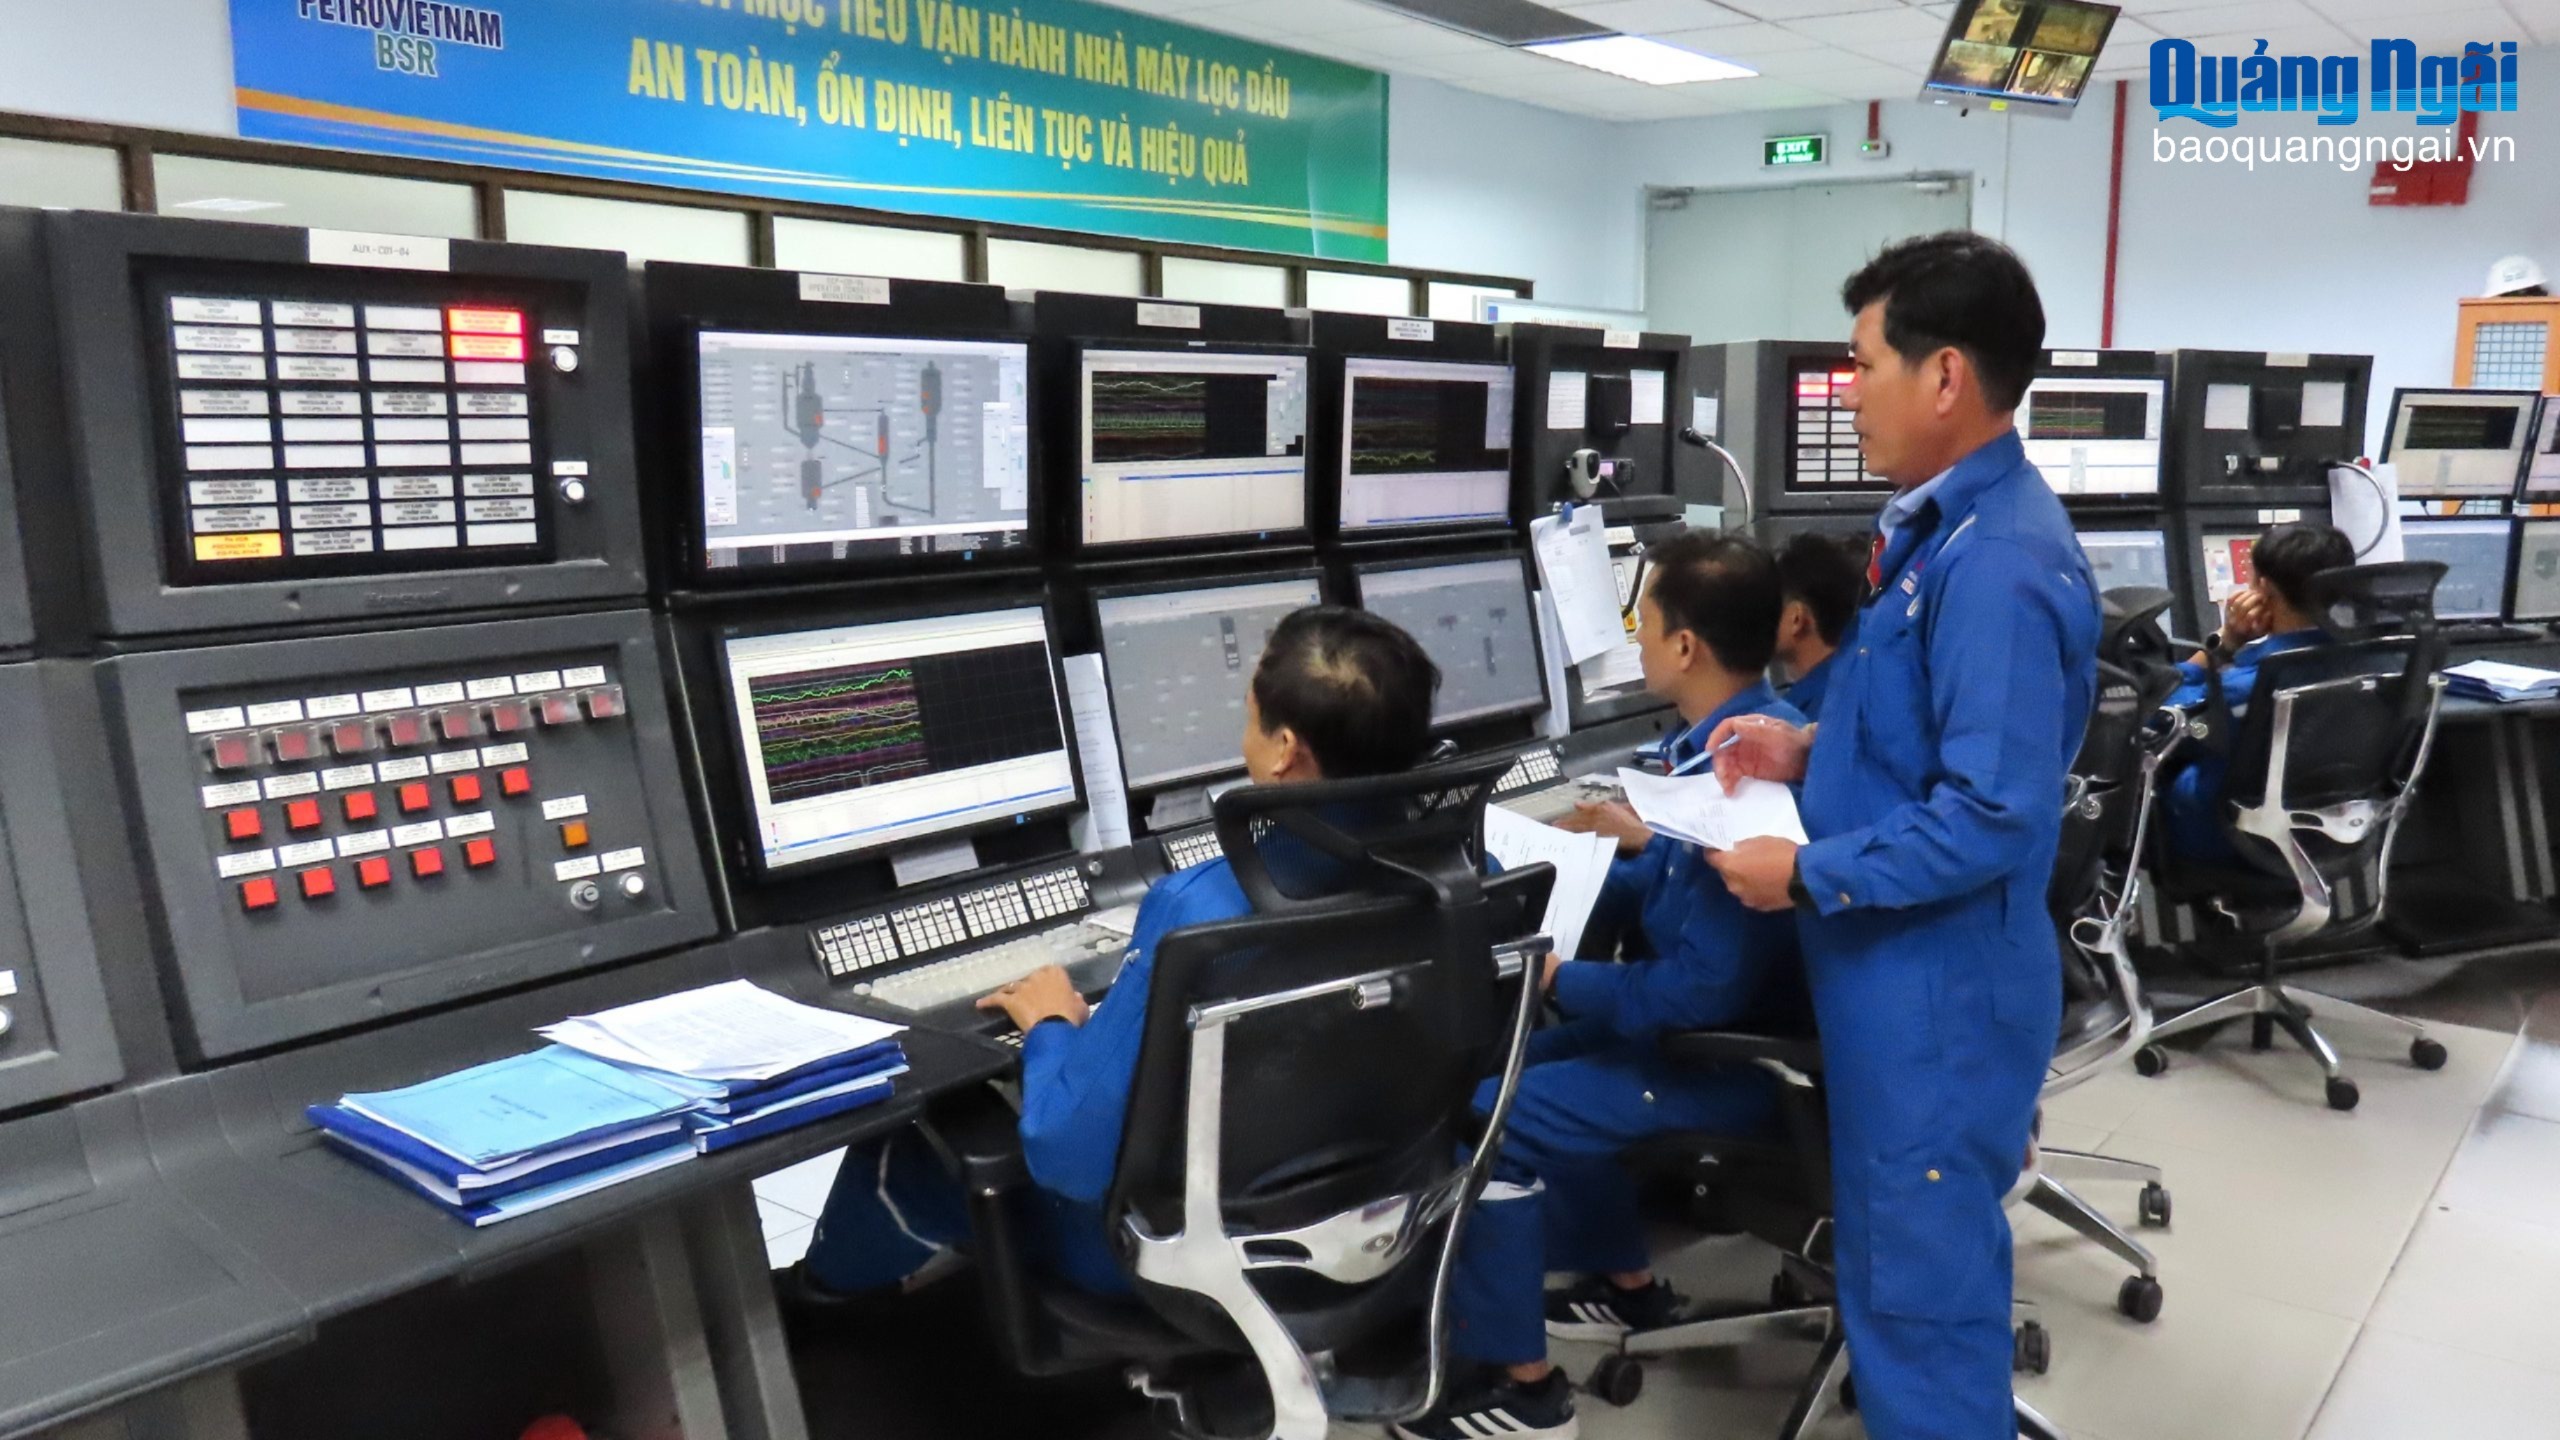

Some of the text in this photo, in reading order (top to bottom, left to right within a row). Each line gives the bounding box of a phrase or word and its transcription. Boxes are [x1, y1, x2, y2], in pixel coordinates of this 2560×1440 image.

[299, 0, 502, 48] PETROVIETNAM
[376, 32, 438, 77] BSR
[915, 0, 981, 64] VẬN
[988, 8, 1067, 76] HÀNH
[1074, 31, 1130, 88] NHÀ
[1136, 42, 1191, 99] MÁY
[1197, 59, 1240, 116] LỌC
[1246, 59, 1291, 120] DẦU
[629, 38, 1249, 186] AN TOÀN, ỔN ĐỊNH, LIÊN TỤC VÀ HIỆU QUẢ
[1776, 140, 1811, 154] EXIT
